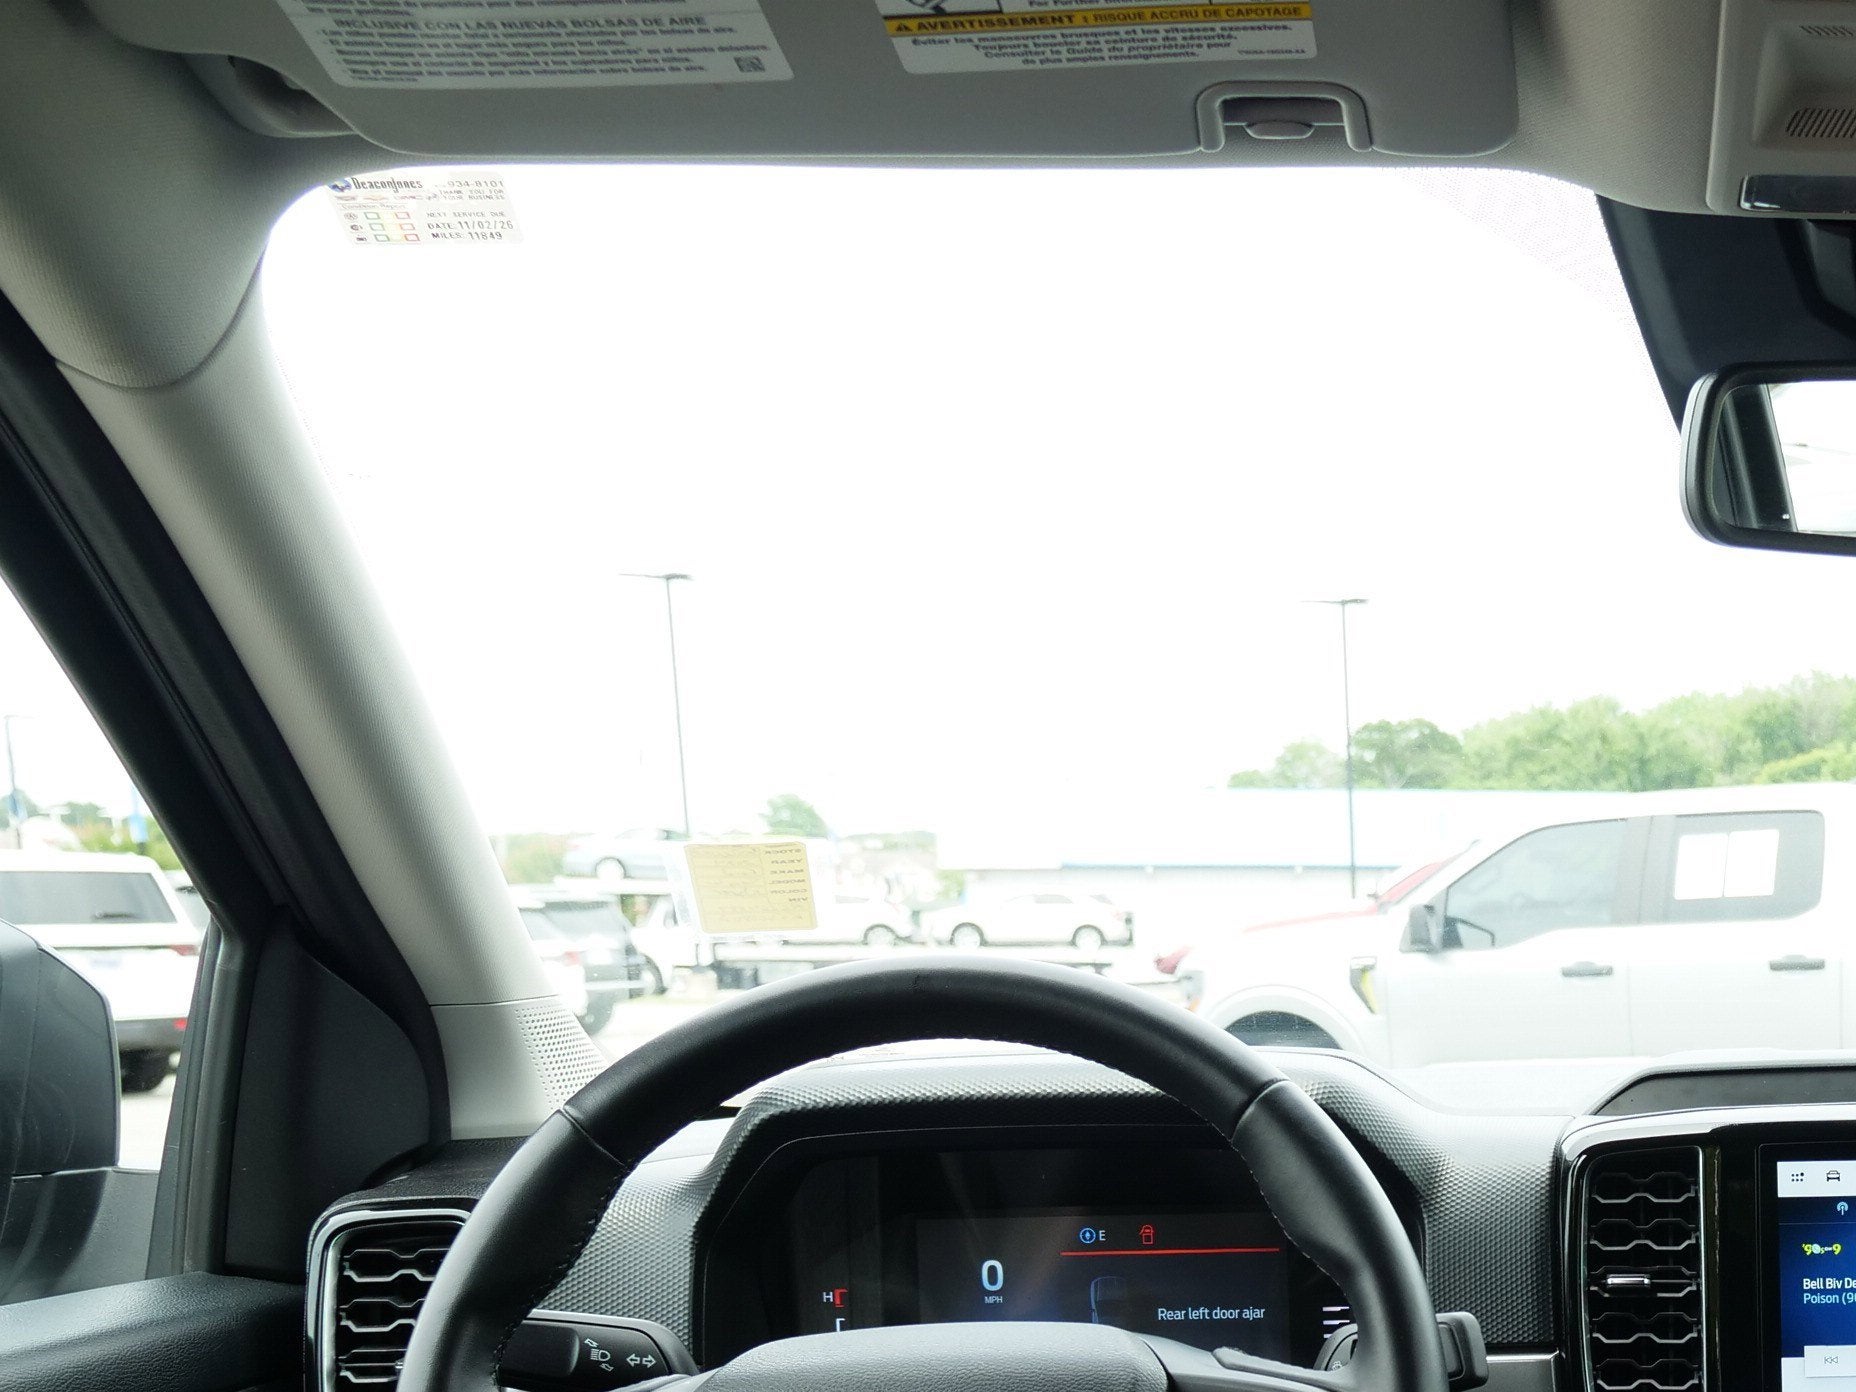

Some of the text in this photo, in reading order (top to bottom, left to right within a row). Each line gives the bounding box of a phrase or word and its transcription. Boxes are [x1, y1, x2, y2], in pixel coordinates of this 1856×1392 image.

[917, 6, 1300, 31] AVERTISSEMENT RISQUE ACCRU DE CAPOTAGE
[1099, 1230, 1106, 1241] E
[981, 1259, 1004, 1291] 0
[1803, 1278, 1823, 1290] Bell
[1826, 1278, 1842, 1289] Biv
[823, 1291, 833, 1302] H
[984, 1295, 1003, 1303] MPH
[1803, 1293, 1840, 1304] Poison
[1157, 1307, 1266, 1322] Rear left door ajar
